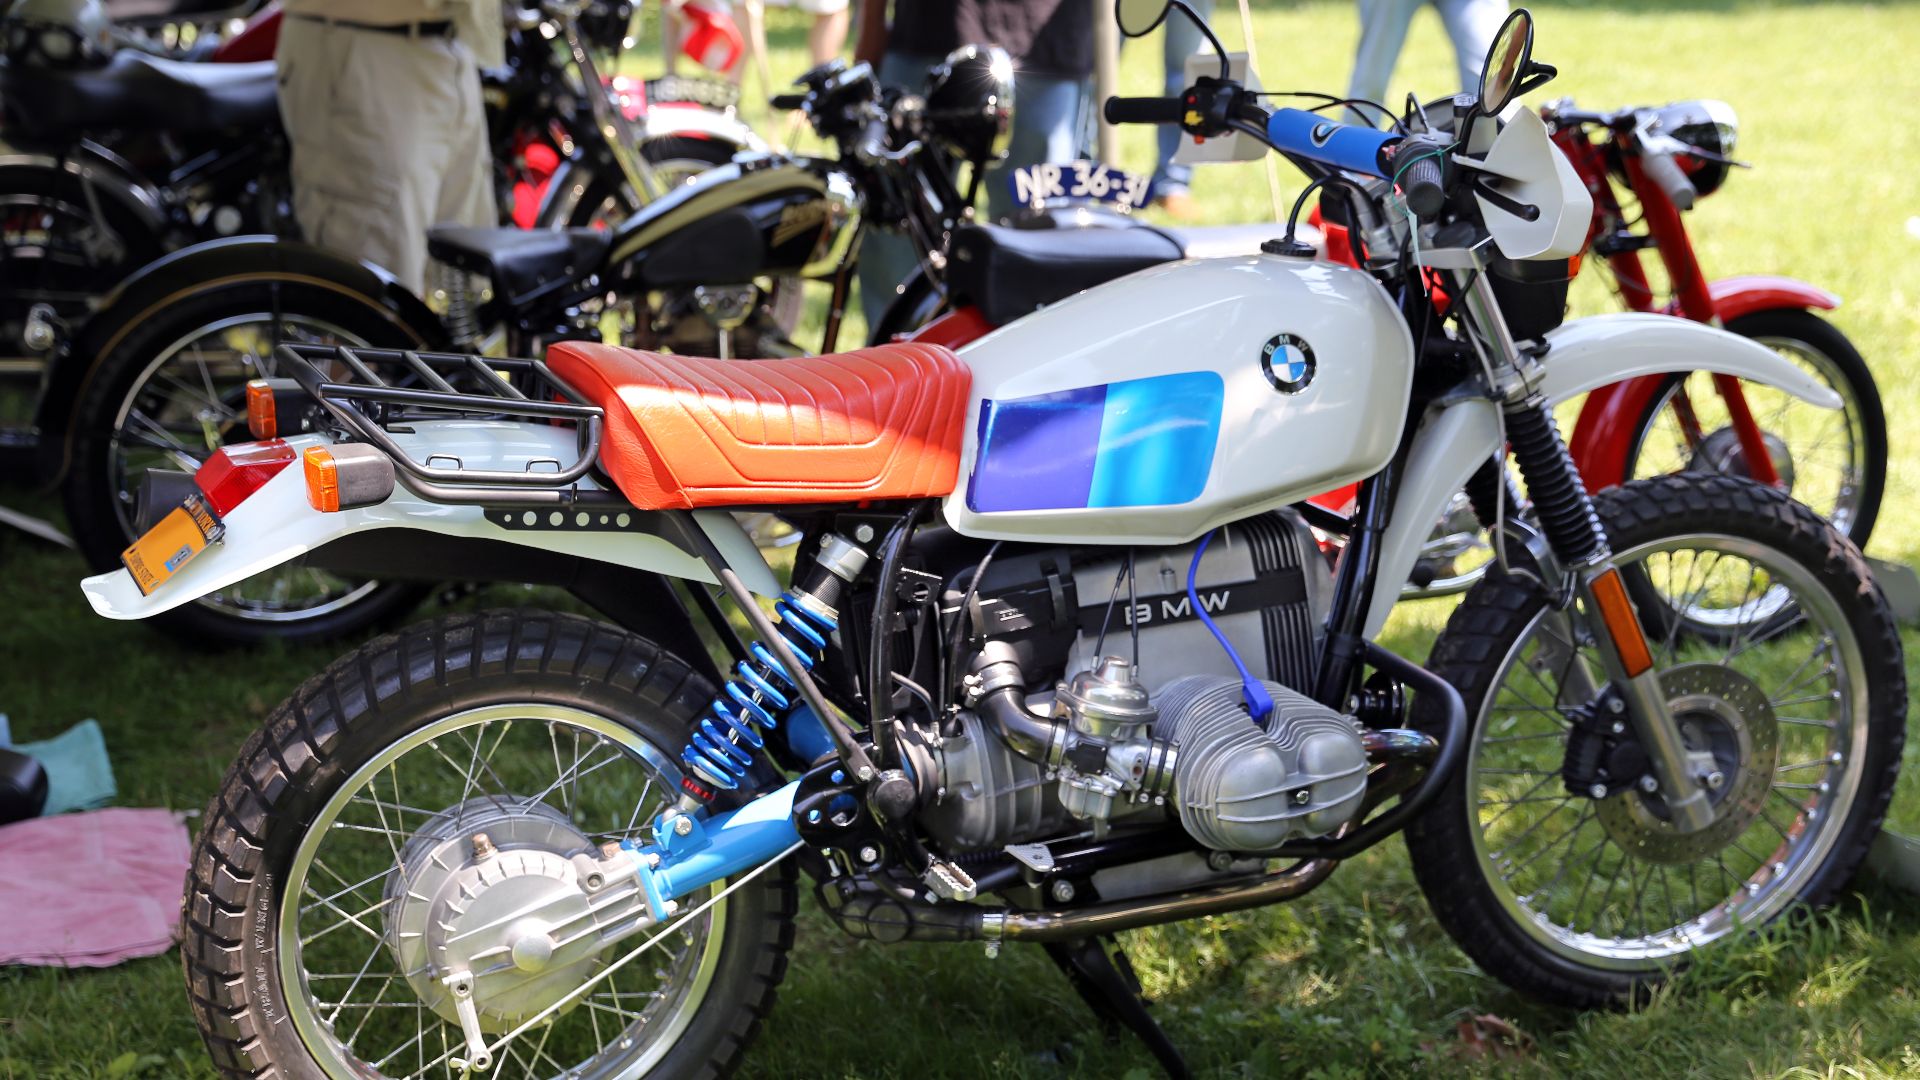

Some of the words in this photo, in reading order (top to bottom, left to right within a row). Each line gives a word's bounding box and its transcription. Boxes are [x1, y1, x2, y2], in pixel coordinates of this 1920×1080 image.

[1014, 162, 1065, 203] NR
[1070, 158, 1153, 206] 36-31
[1263, 333, 1309, 356] BMW
[1124, 590, 1230, 625] BMW
